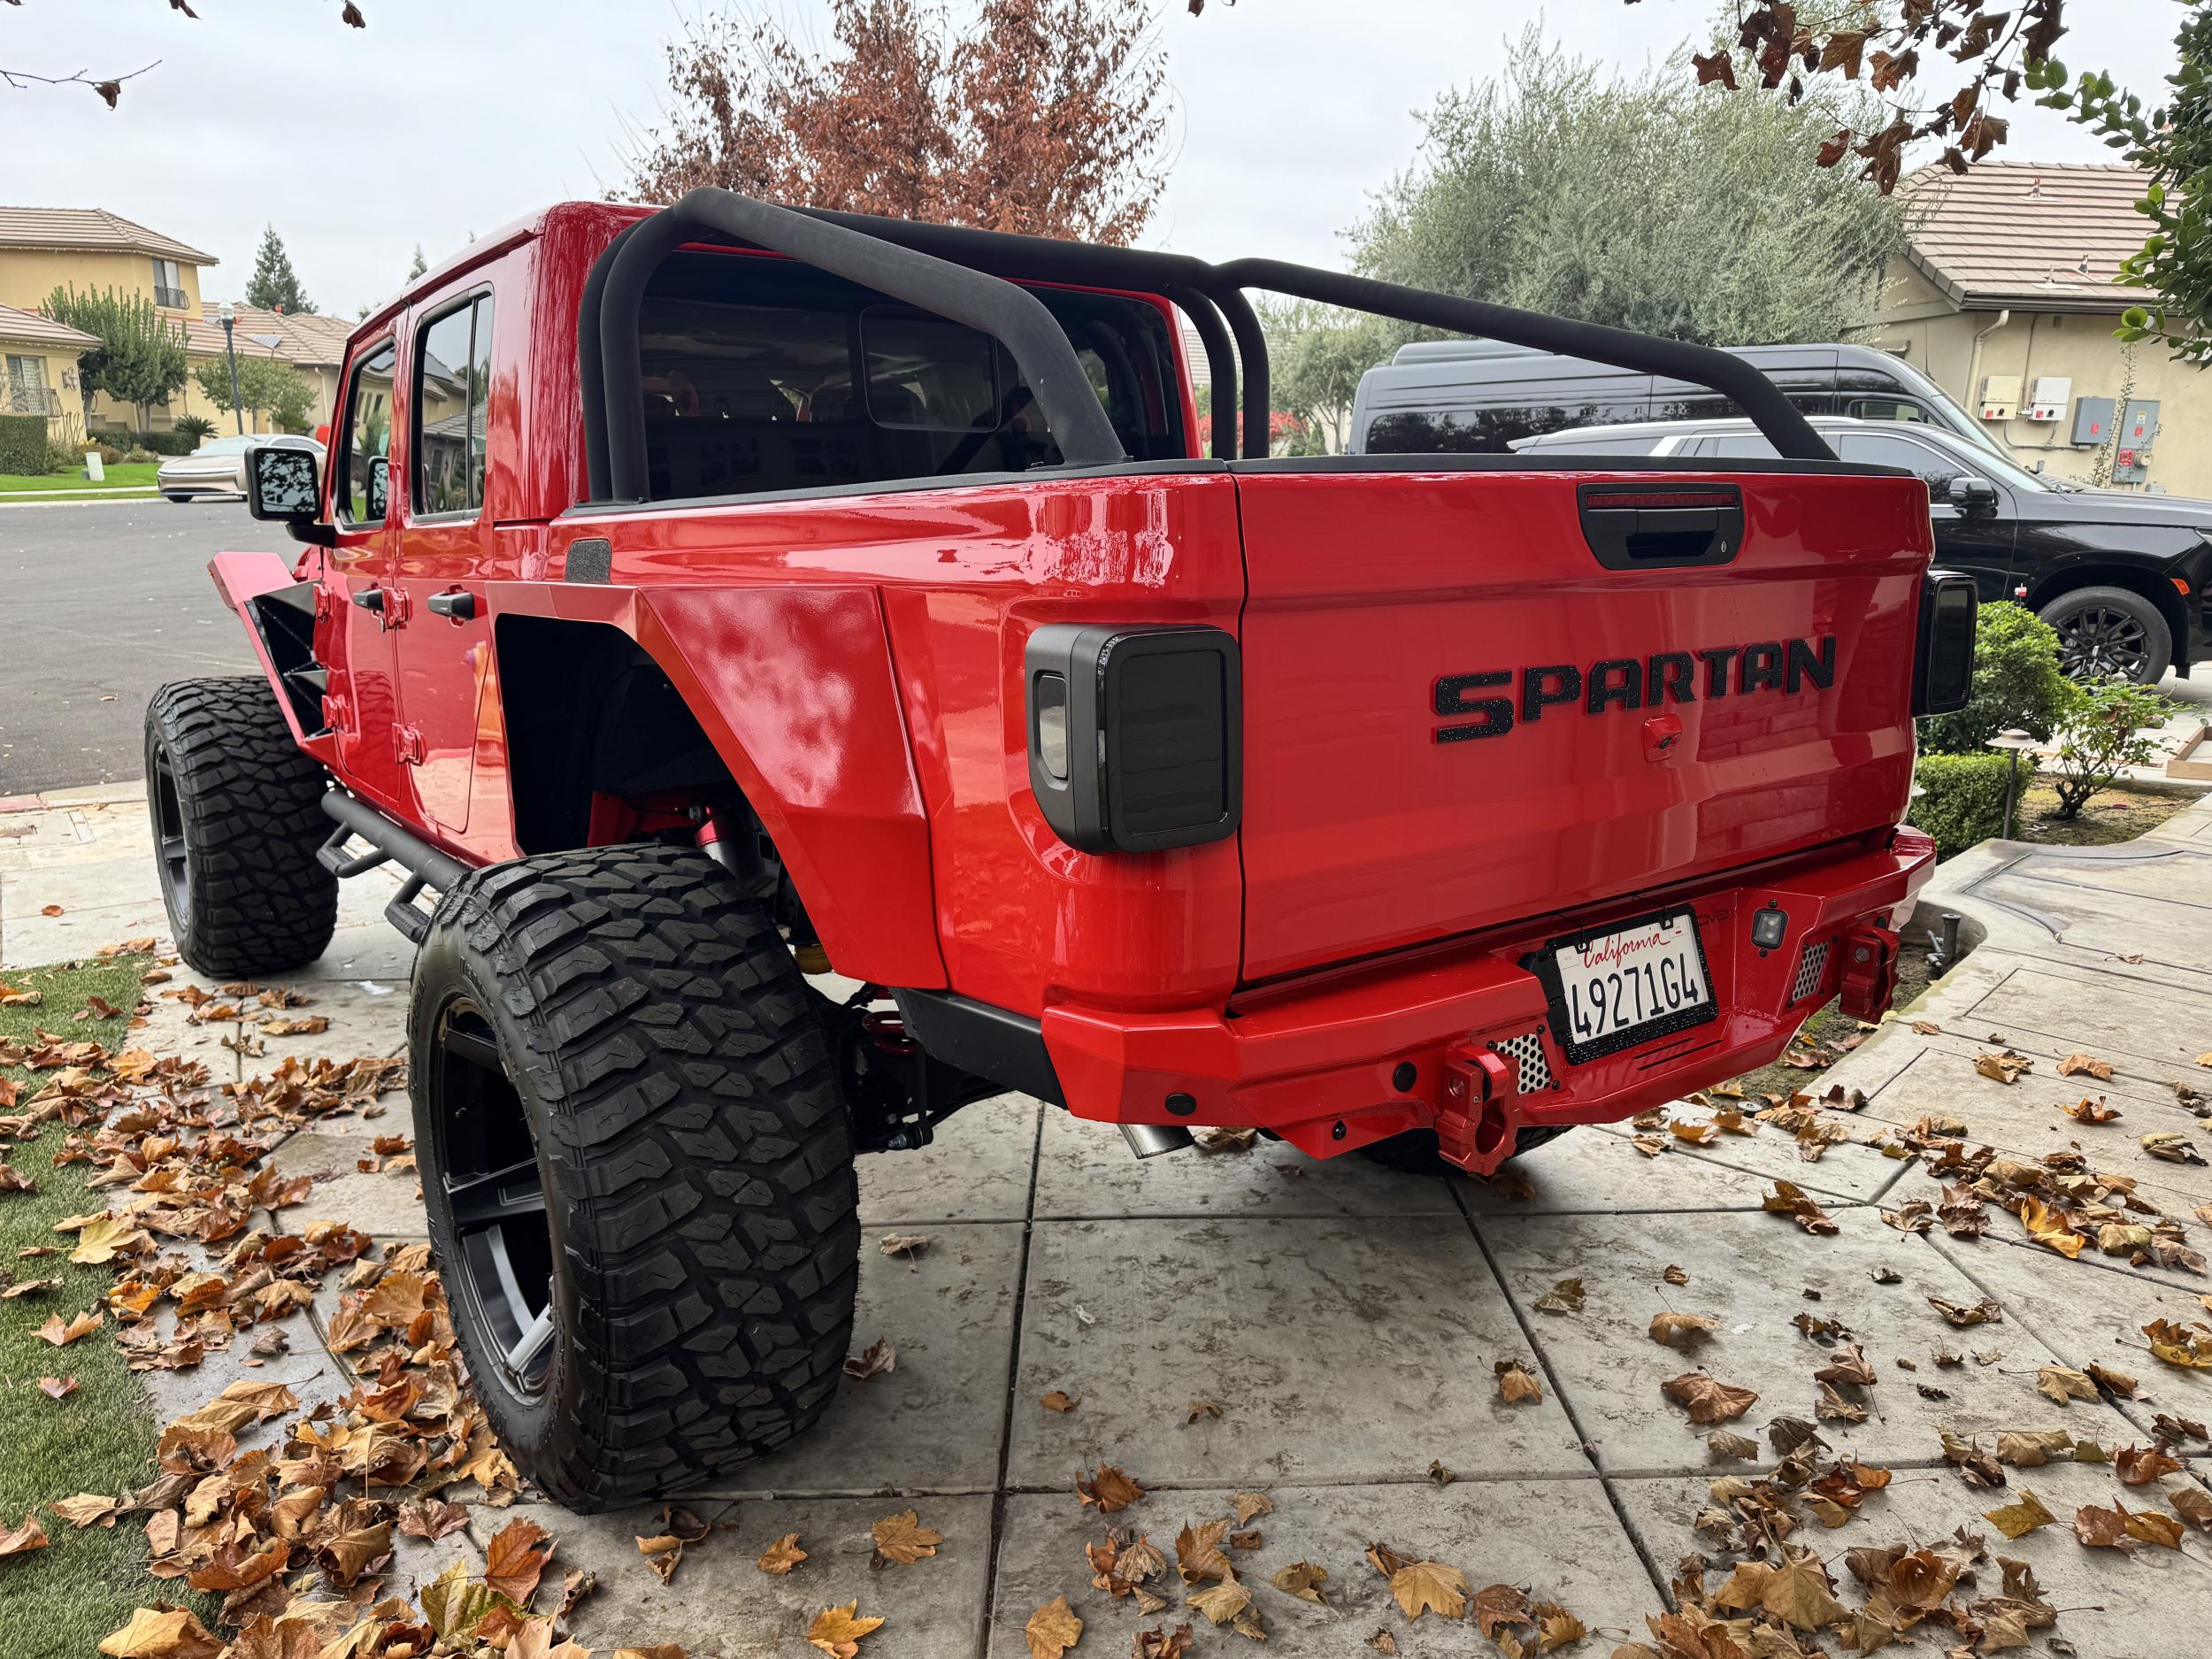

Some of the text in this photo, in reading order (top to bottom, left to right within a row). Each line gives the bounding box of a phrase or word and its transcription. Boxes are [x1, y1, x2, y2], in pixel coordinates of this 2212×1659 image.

[1432, 636, 1837, 744] SPARTAN
[1583, 927, 1671, 968] California
[1571, 952, 1698, 1037] 49271G4
